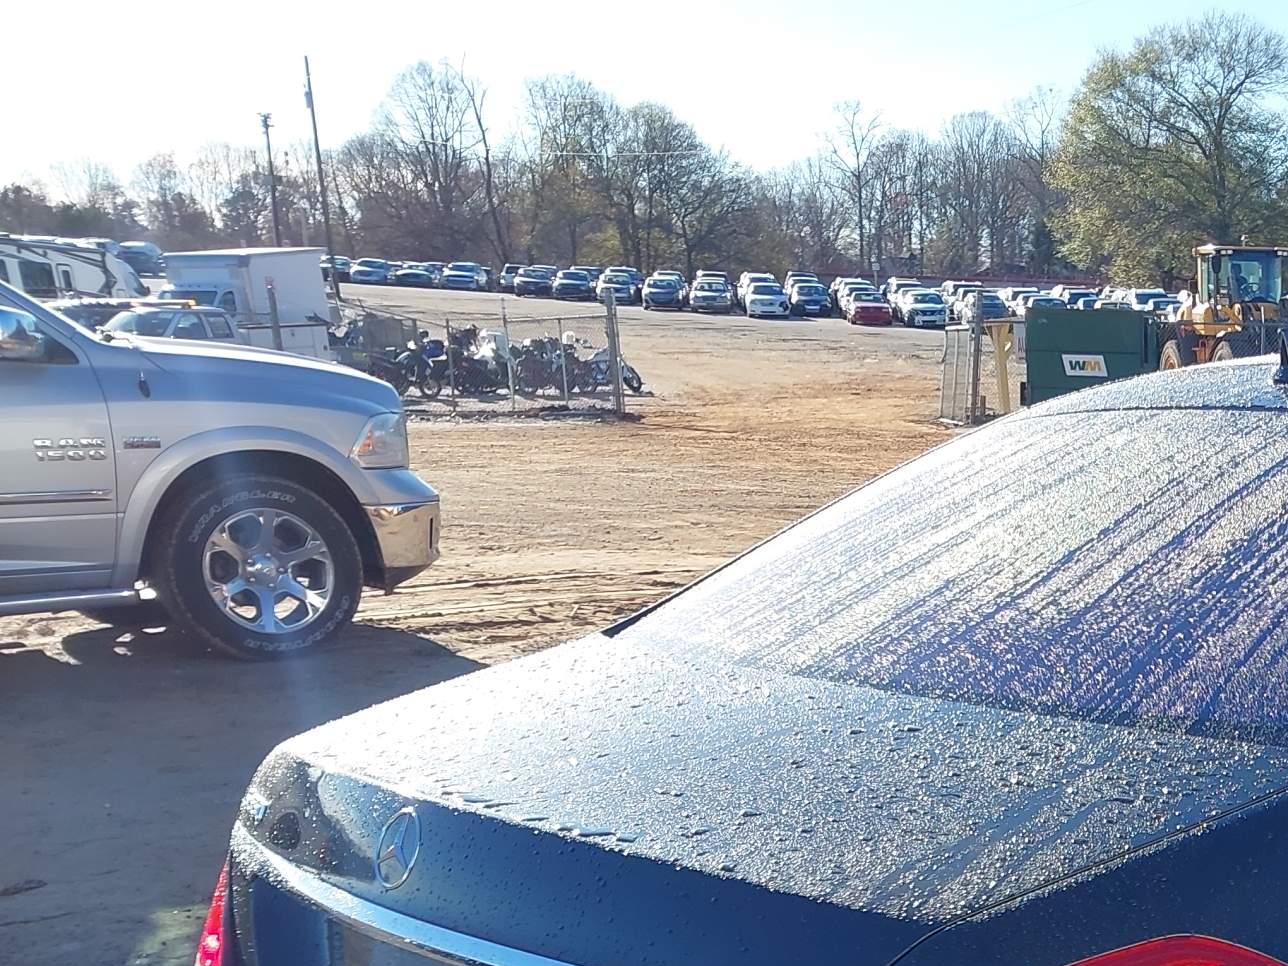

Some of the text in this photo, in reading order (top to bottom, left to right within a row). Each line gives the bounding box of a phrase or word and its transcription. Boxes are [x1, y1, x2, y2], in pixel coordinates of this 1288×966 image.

[1068, 360, 1101, 371] WM
[33, 438, 106, 449] RAM
[36, 450, 107, 461] 1500
